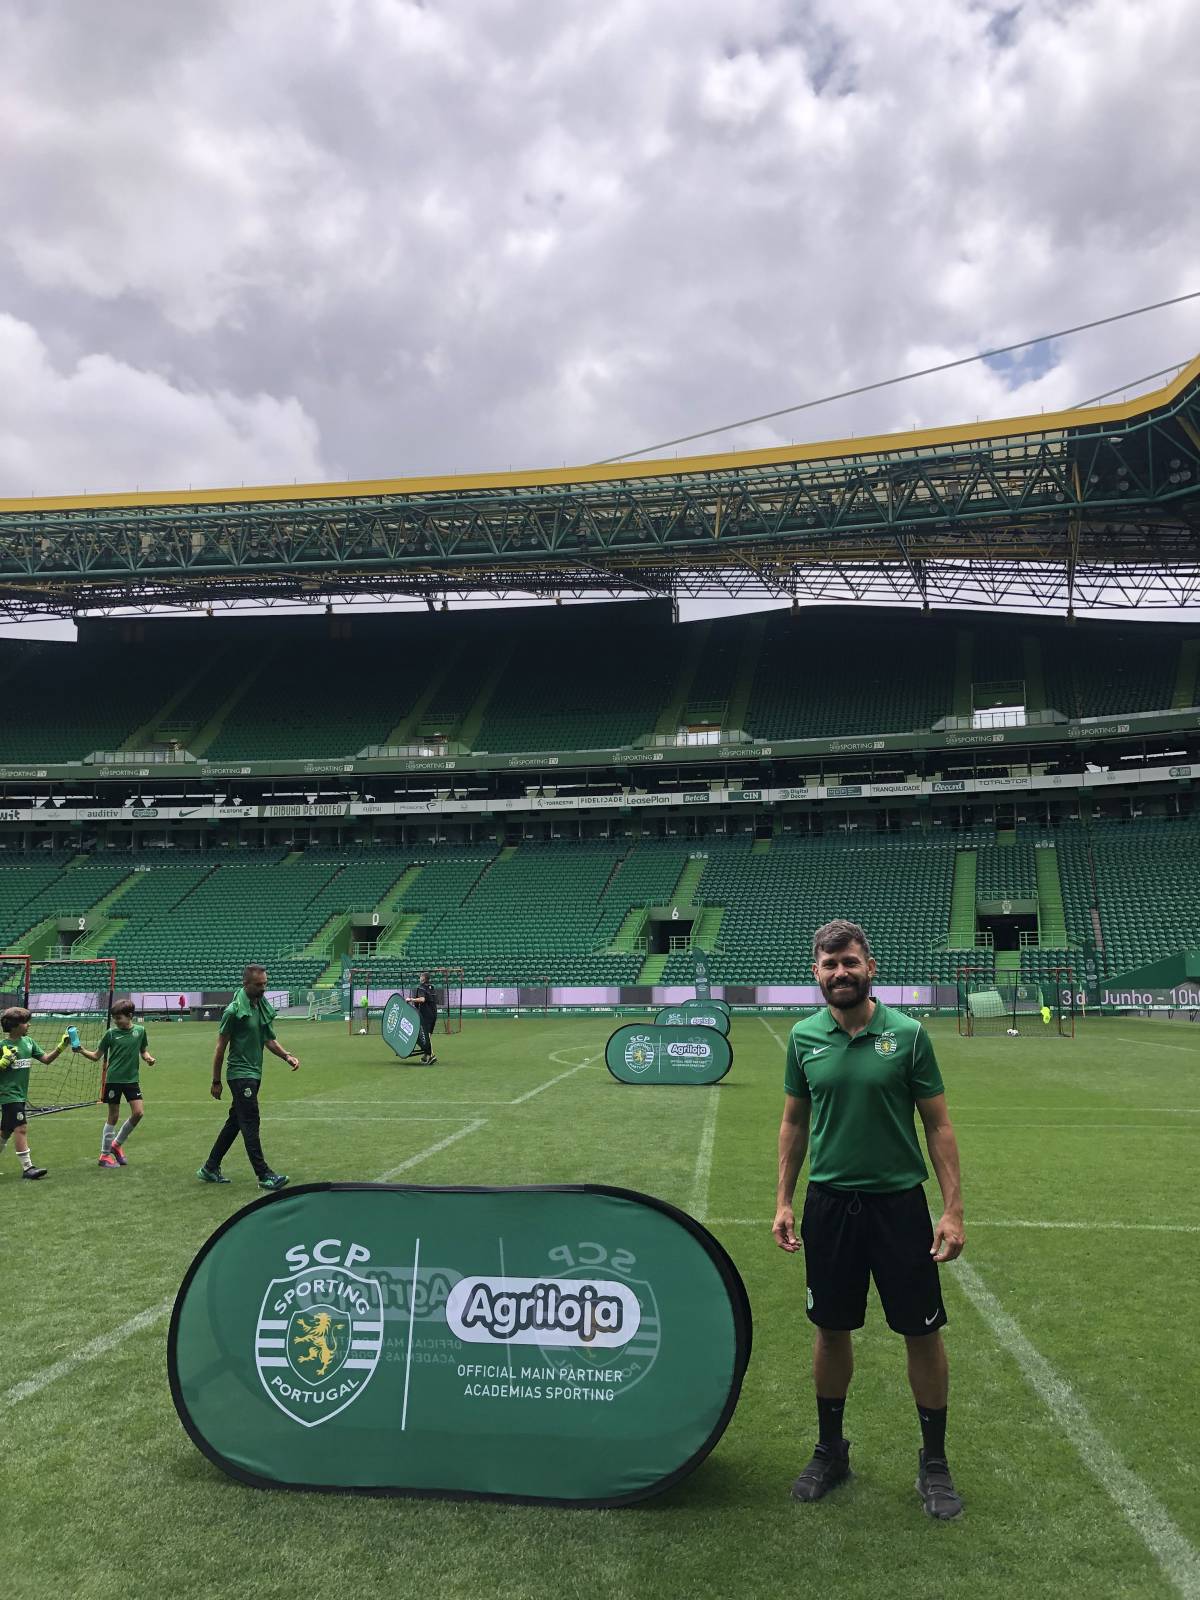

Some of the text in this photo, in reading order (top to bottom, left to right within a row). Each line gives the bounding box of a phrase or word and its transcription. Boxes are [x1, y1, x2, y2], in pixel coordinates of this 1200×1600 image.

[1081, 725, 1130, 735] SPORTING TV
[957, 734, 1004, 744] SPORTING TV
[873, 741, 885, 749] TV
[730, 749, 761, 757] SPORTING
[872, 784, 921, 793] TRANQUILIDADE
[934, 781, 963, 791] Record
[580, 796, 623, 804] FIDELIDADE
[626, 795, 670, 805] LeasePlan
[684, 794, 708, 802] Betclic
[742, 792, 760, 800] CIN
[87, 810, 119, 818] auditiv
[269, 804, 342, 817] TRIBUNA PEYROTEO
[671, 907, 680, 920] 6
[78, 917, 86, 930] 9
[1062, 989, 1072, 1005] 3
[1101, 989, 1153, 1005] Junho
[1169, 989, 1200, 1005] 10h
[629, 1034, 651, 1043] SCP
[670, 1044, 707, 1057] Agriloja
[285, 1239, 371, 1272] SCP
[273, 1278, 370, 1316] SPORTING
[462, 1284, 623, 1341] Agriloja
[457, 1364, 623, 1383] OFFICIAL MAIN PARTNER
[270, 1375, 360, 1404] PORTUGAL
[464, 1384, 615, 1402] ACADEMIAS SPORTING
